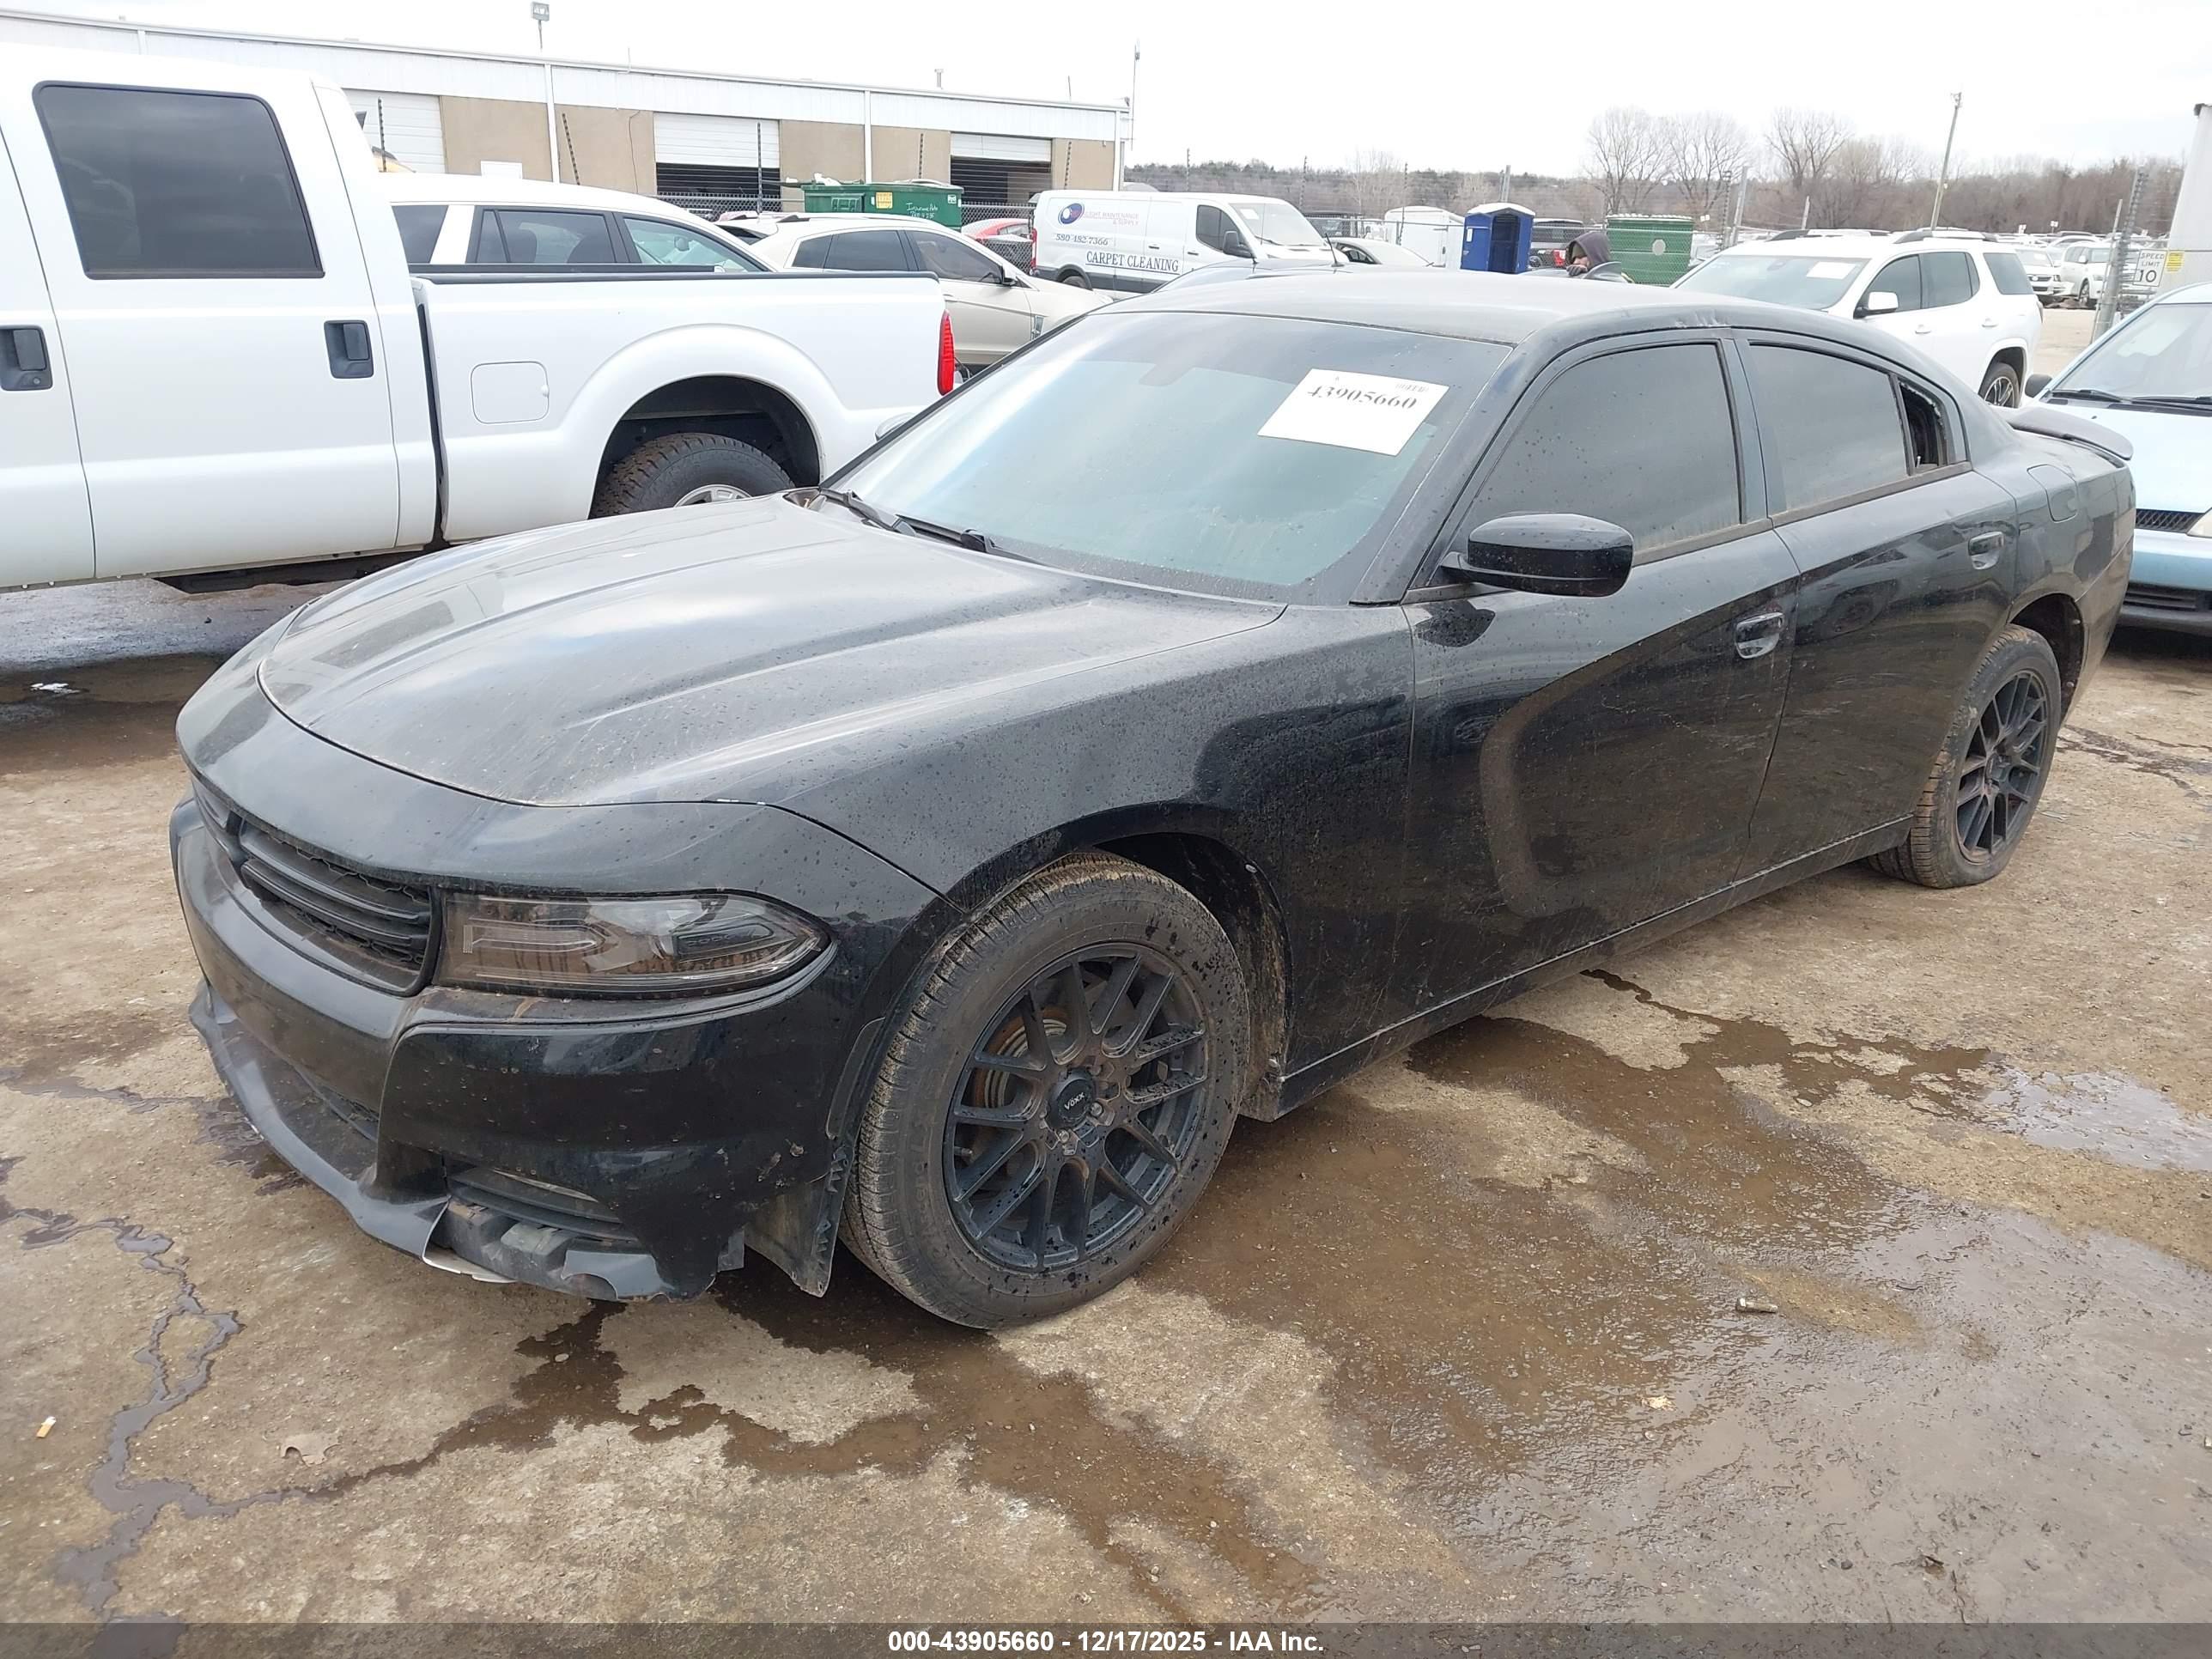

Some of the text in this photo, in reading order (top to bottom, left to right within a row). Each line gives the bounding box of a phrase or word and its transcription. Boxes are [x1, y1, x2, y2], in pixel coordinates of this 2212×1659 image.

[1086, 251, 1179, 272] CARPET CLEANING
[2140, 270, 2157, 283] 10
[1308, 386, 1417, 409] 43905660
